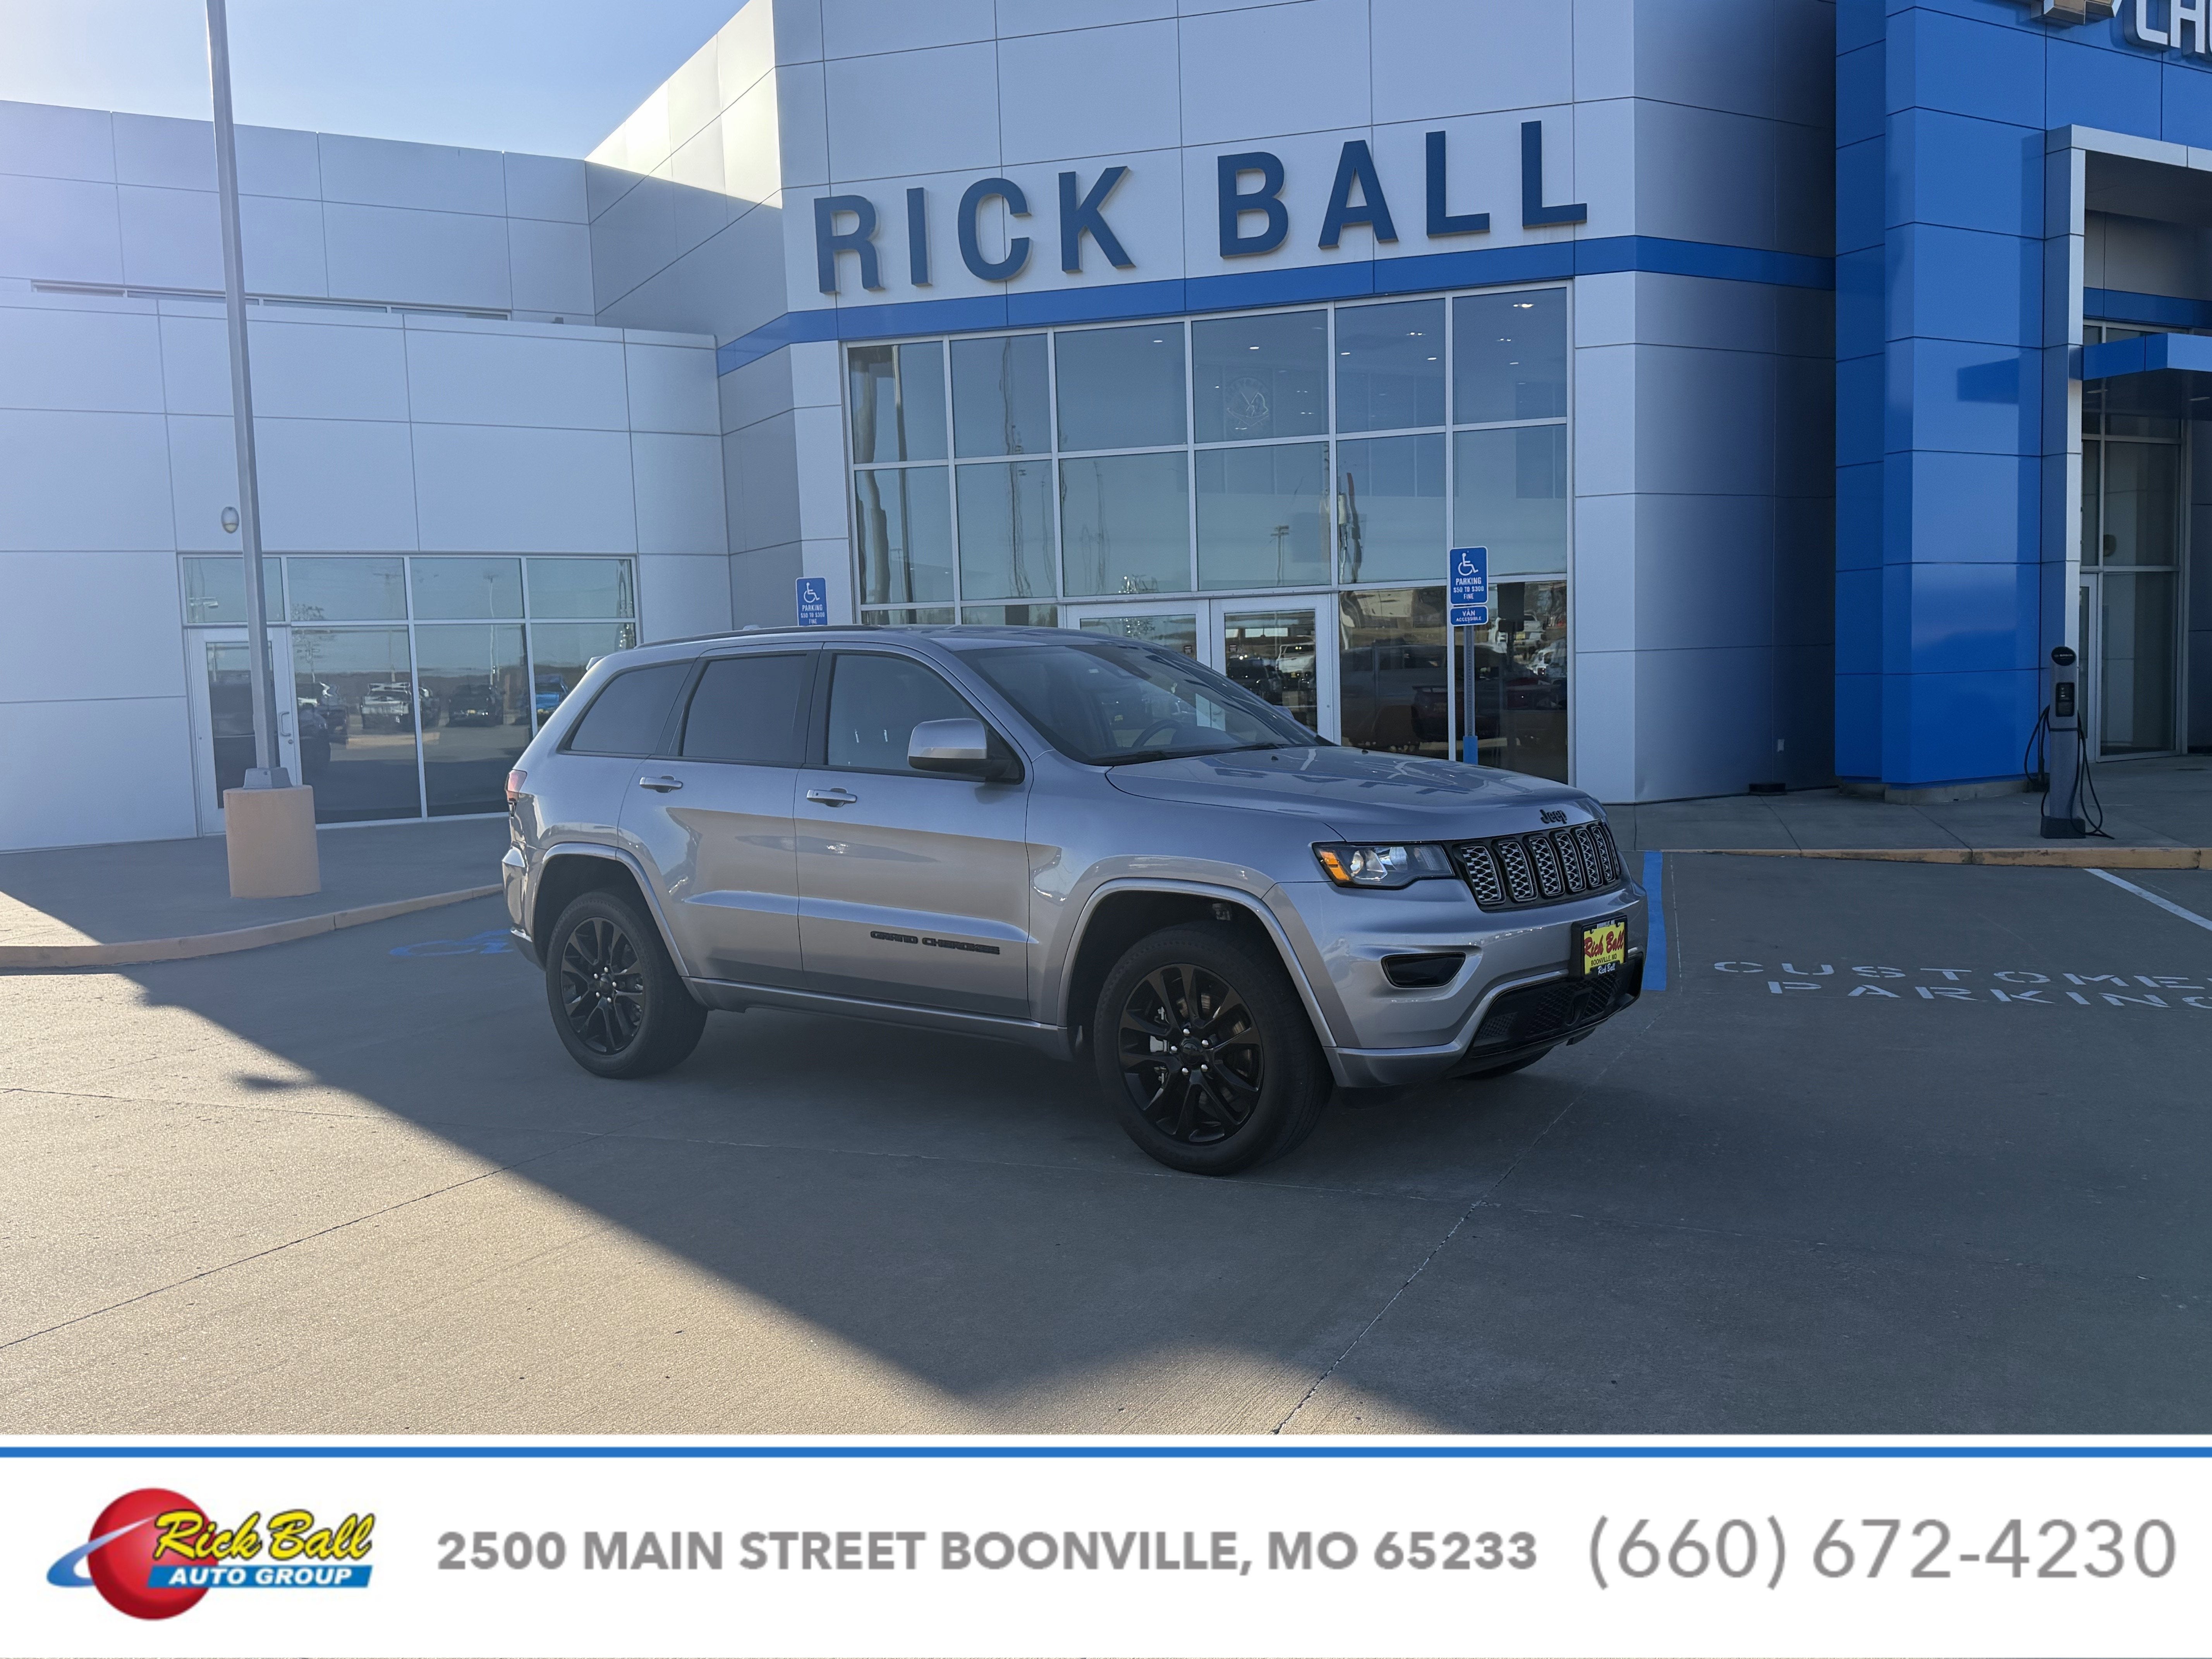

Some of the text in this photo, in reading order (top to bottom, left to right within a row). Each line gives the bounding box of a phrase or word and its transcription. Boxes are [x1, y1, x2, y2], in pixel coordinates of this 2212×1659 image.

[2136, 0, 2212, 54] CH
[814, 120, 1588, 295] RICK BALL
[1456, 577, 1482, 586] PARKING
[1539, 809, 1567, 824] Jeep
[870, 930, 1000, 955] GRAND CHEROKEE
[1584, 929, 1625, 958] Rick Ball
[1714, 962, 2212, 989] CUSTOME
